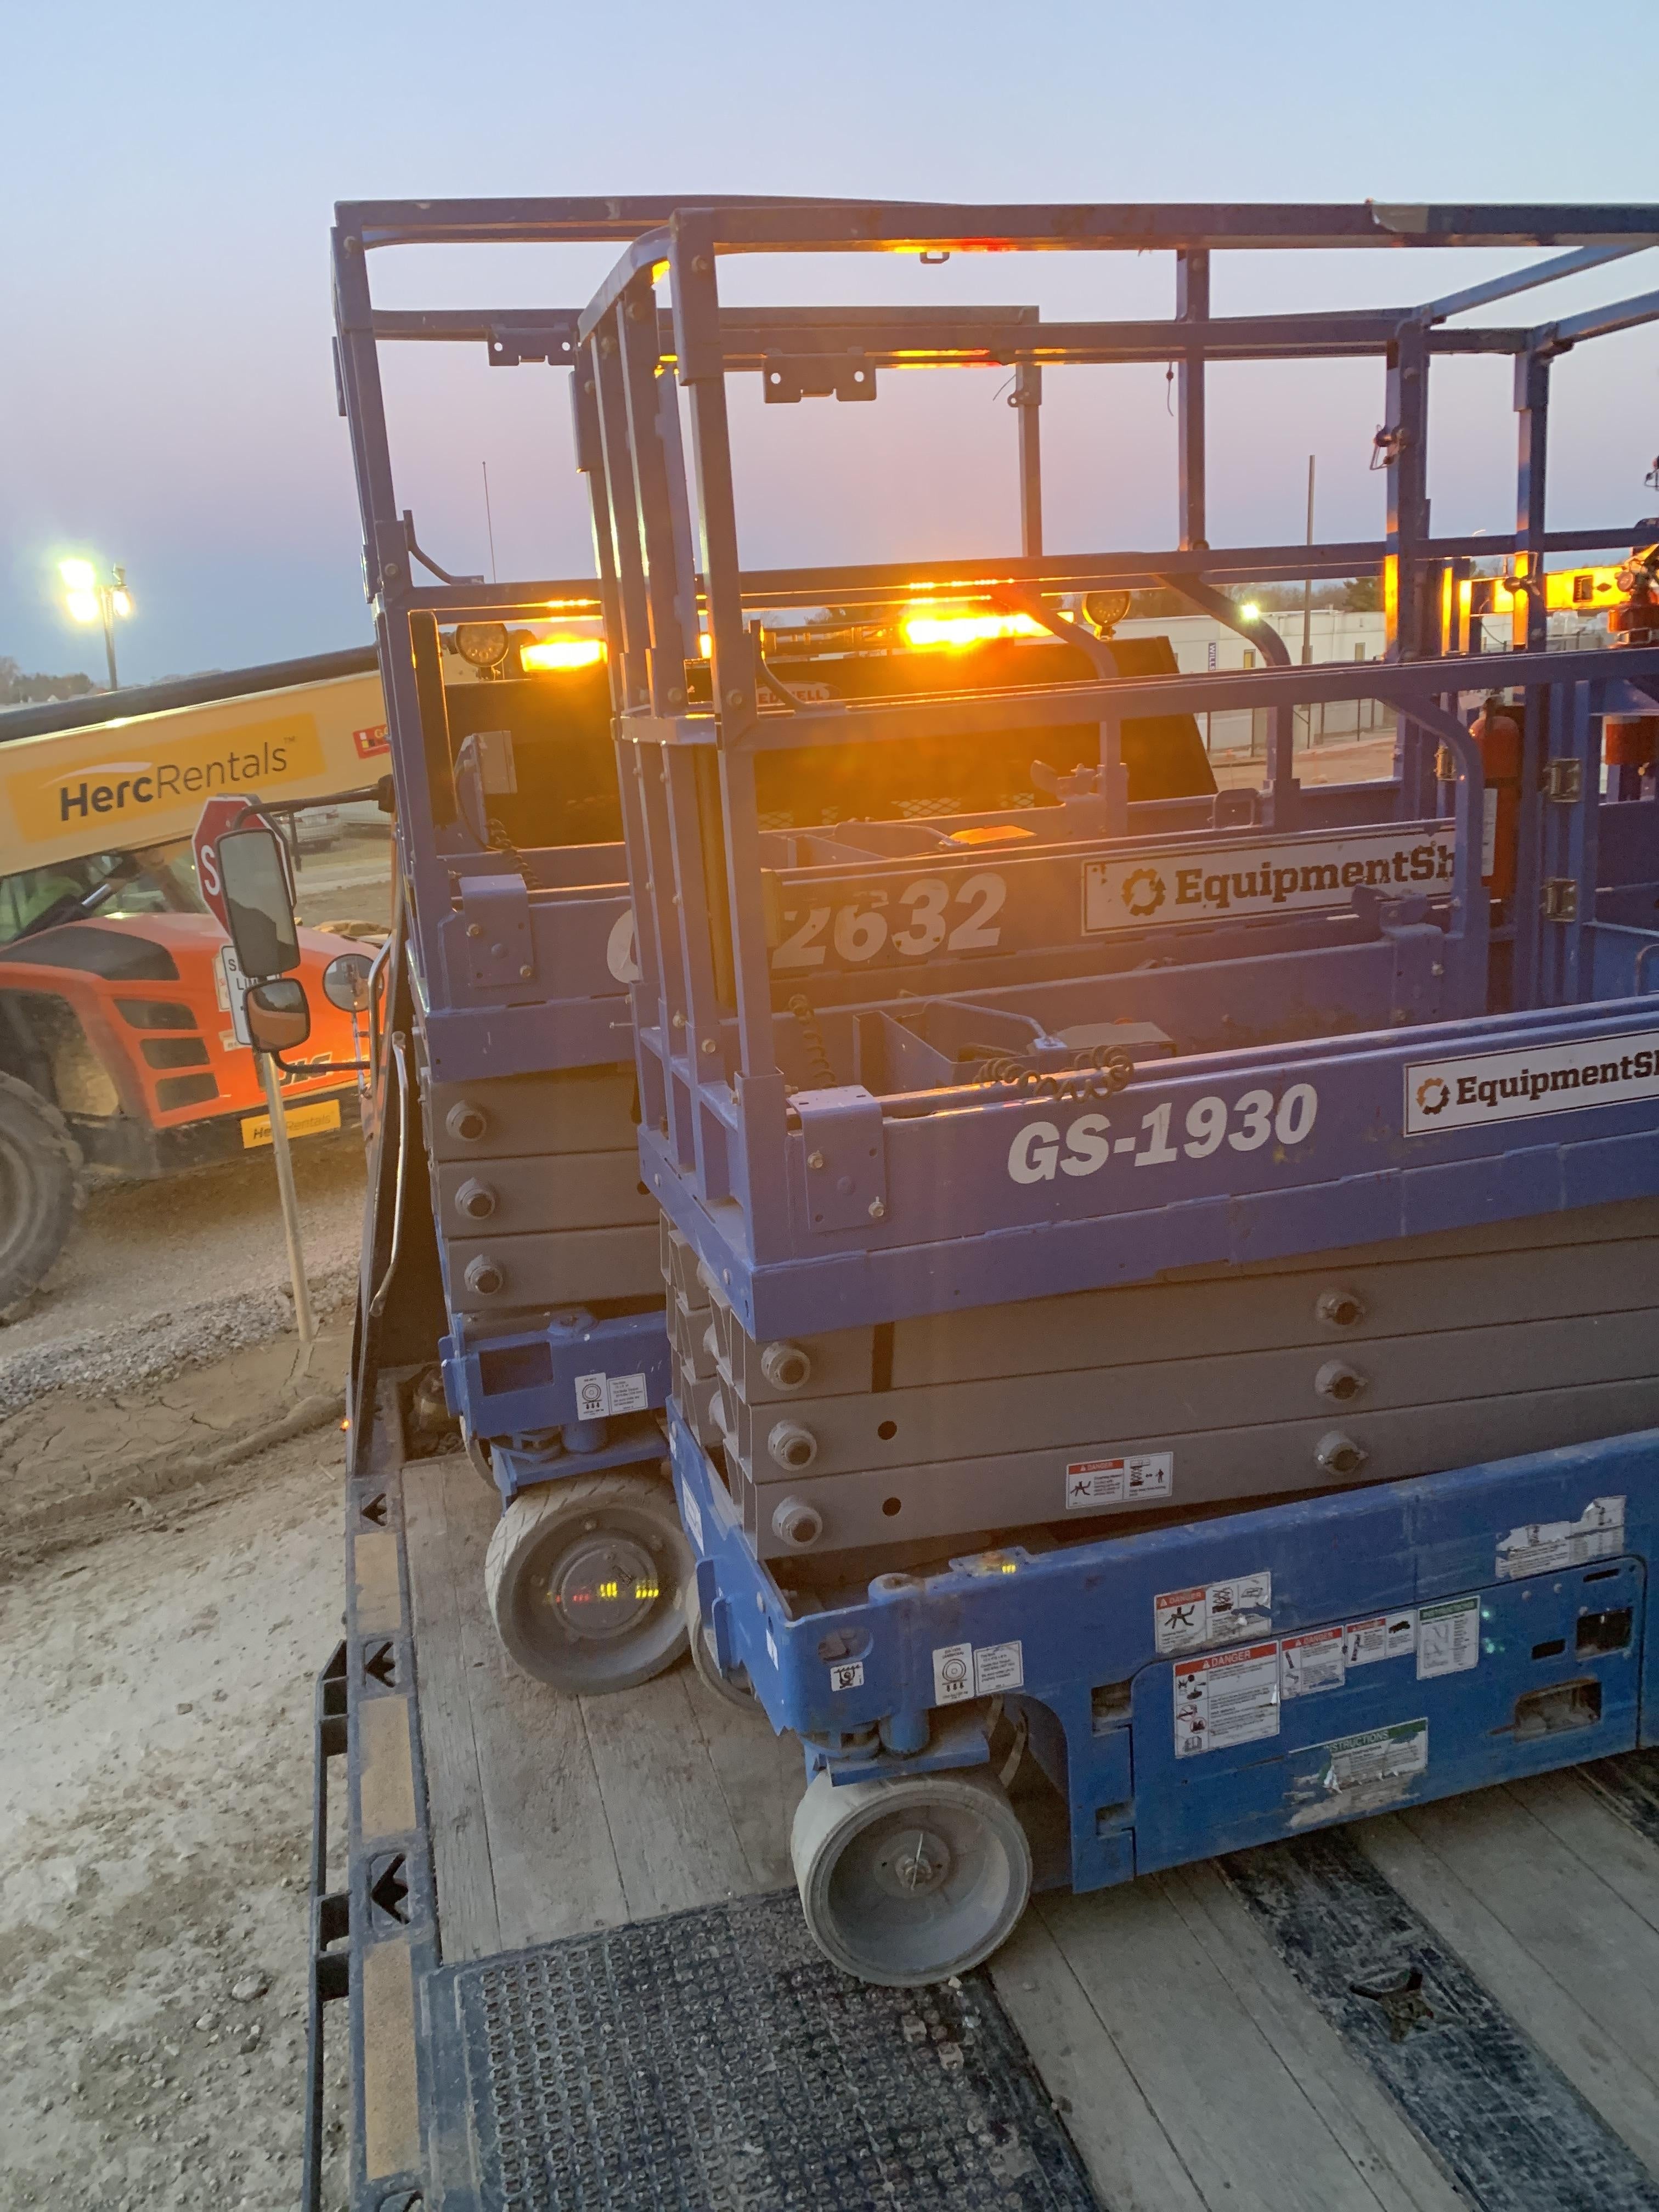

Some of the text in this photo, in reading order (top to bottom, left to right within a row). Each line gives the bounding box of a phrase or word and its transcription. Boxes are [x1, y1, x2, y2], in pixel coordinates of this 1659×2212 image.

[60, 742, 287, 821] HercRentals
[1008, 1084, 1317, 1184] GS-1930
[1211, 1650, 1251, 1667] DANGER
